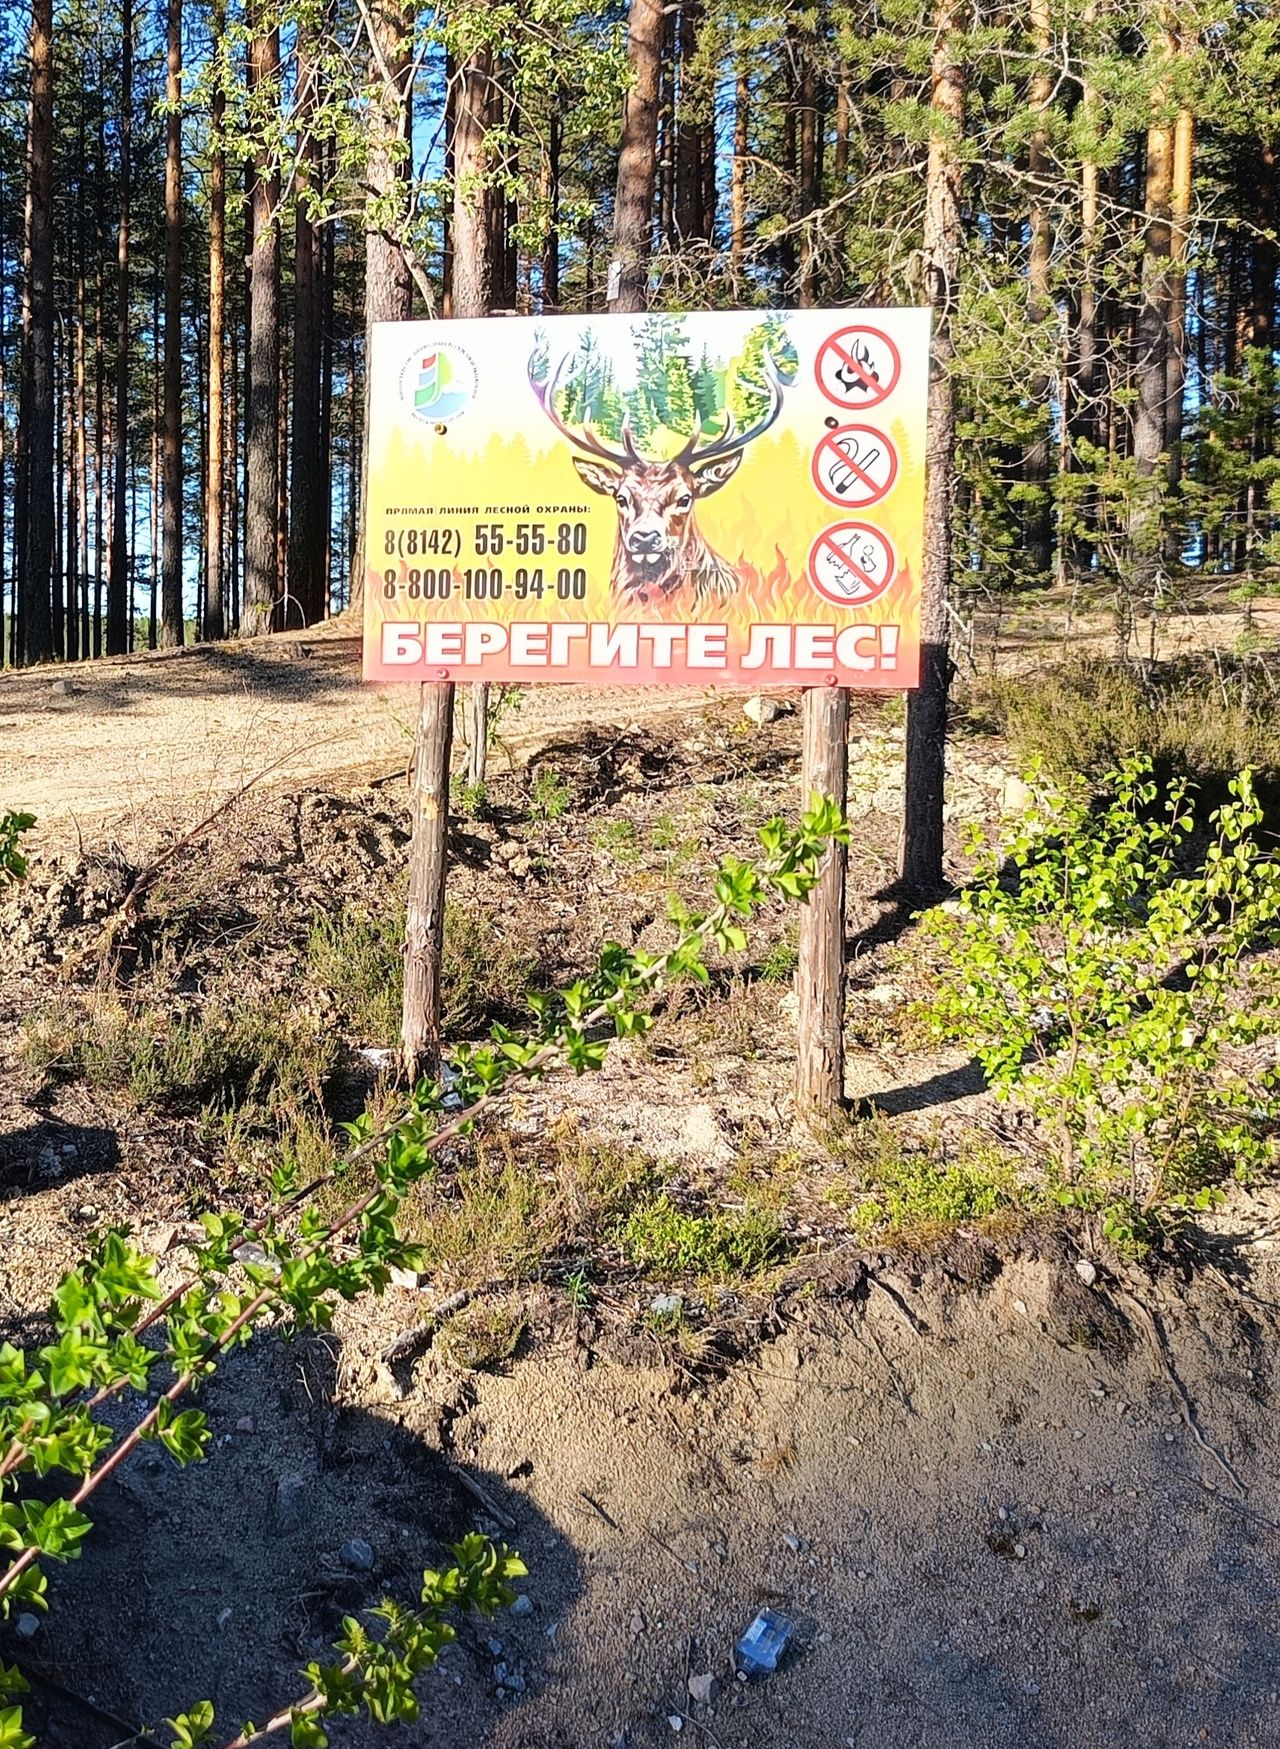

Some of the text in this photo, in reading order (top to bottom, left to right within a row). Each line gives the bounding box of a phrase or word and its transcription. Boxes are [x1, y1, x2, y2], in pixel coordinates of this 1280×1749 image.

[439, 506, 479, 514] ЛИНИЯ
[484, 504, 530, 514] ЛЕСНОЙ
[536, 505, 591, 513] ОХРАНЫ:
[384, 523, 587, 558] 8(8142) 55-55-80
[383, 568, 587, 600] 8-800-100-94-00
[381, 622, 901, 670] БЕРЕГИТЕ ЛЕС!
